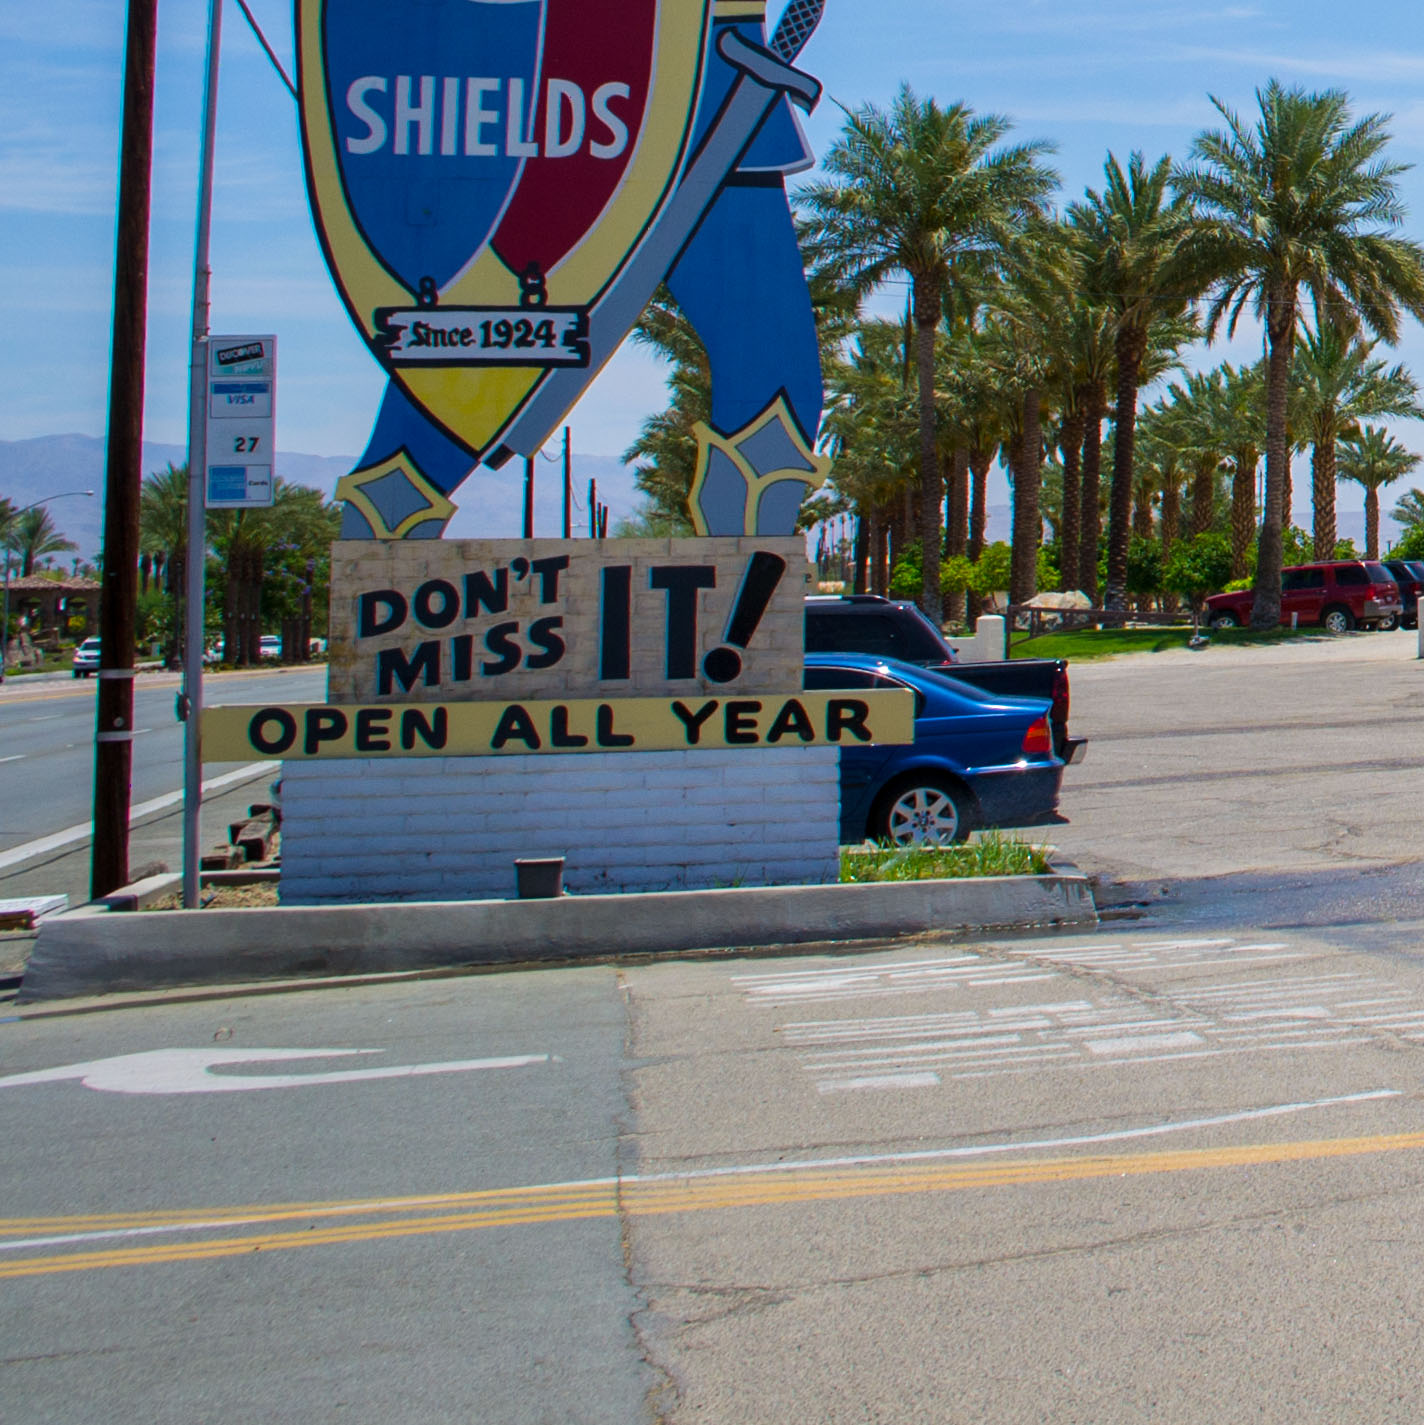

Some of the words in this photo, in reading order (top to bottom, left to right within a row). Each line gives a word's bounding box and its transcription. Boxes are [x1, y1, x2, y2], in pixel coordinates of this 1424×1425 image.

[346, 75, 631, 159] SHIELDS
[407, 321, 476, 347] Since
[479, 318, 557, 349] 1924
[227, 394, 256, 405] VISA
[235, 437, 261, 453] 27
[357, 554, 570, 639] DON'T
[599, 550, 787, 684] IT!
[377, 616, 566, 695] MISS
[248, 704, 448, 755] OPEN
[490, 702, 635, 751] ALL
[671, 697, 874, 745] YEAR
